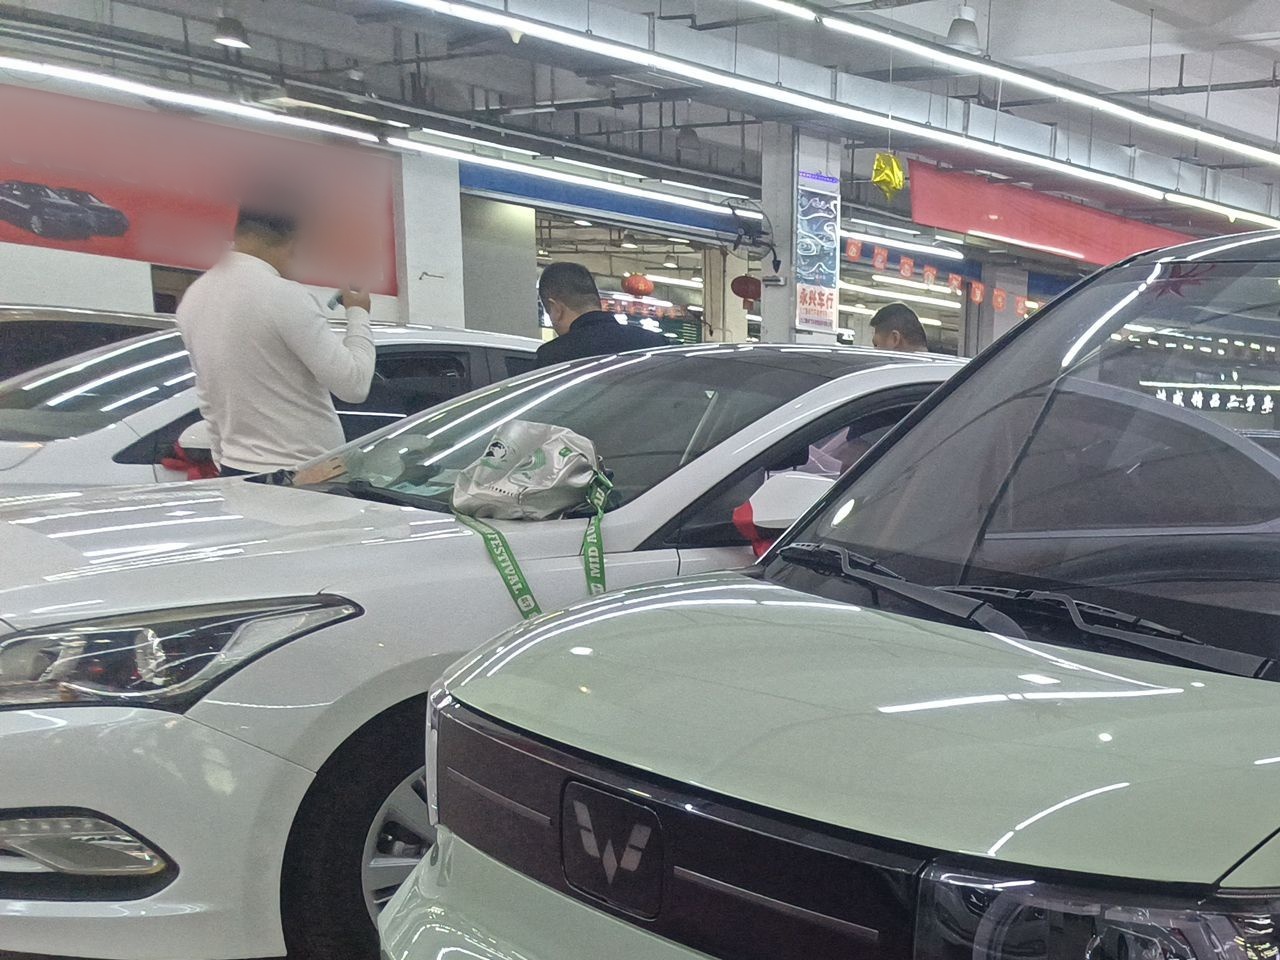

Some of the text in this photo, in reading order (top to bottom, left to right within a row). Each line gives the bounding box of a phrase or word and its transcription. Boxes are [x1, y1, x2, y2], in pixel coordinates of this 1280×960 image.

[799, 288, 834, 309] 永兴车行
[588, 546, 601, 578] MID
